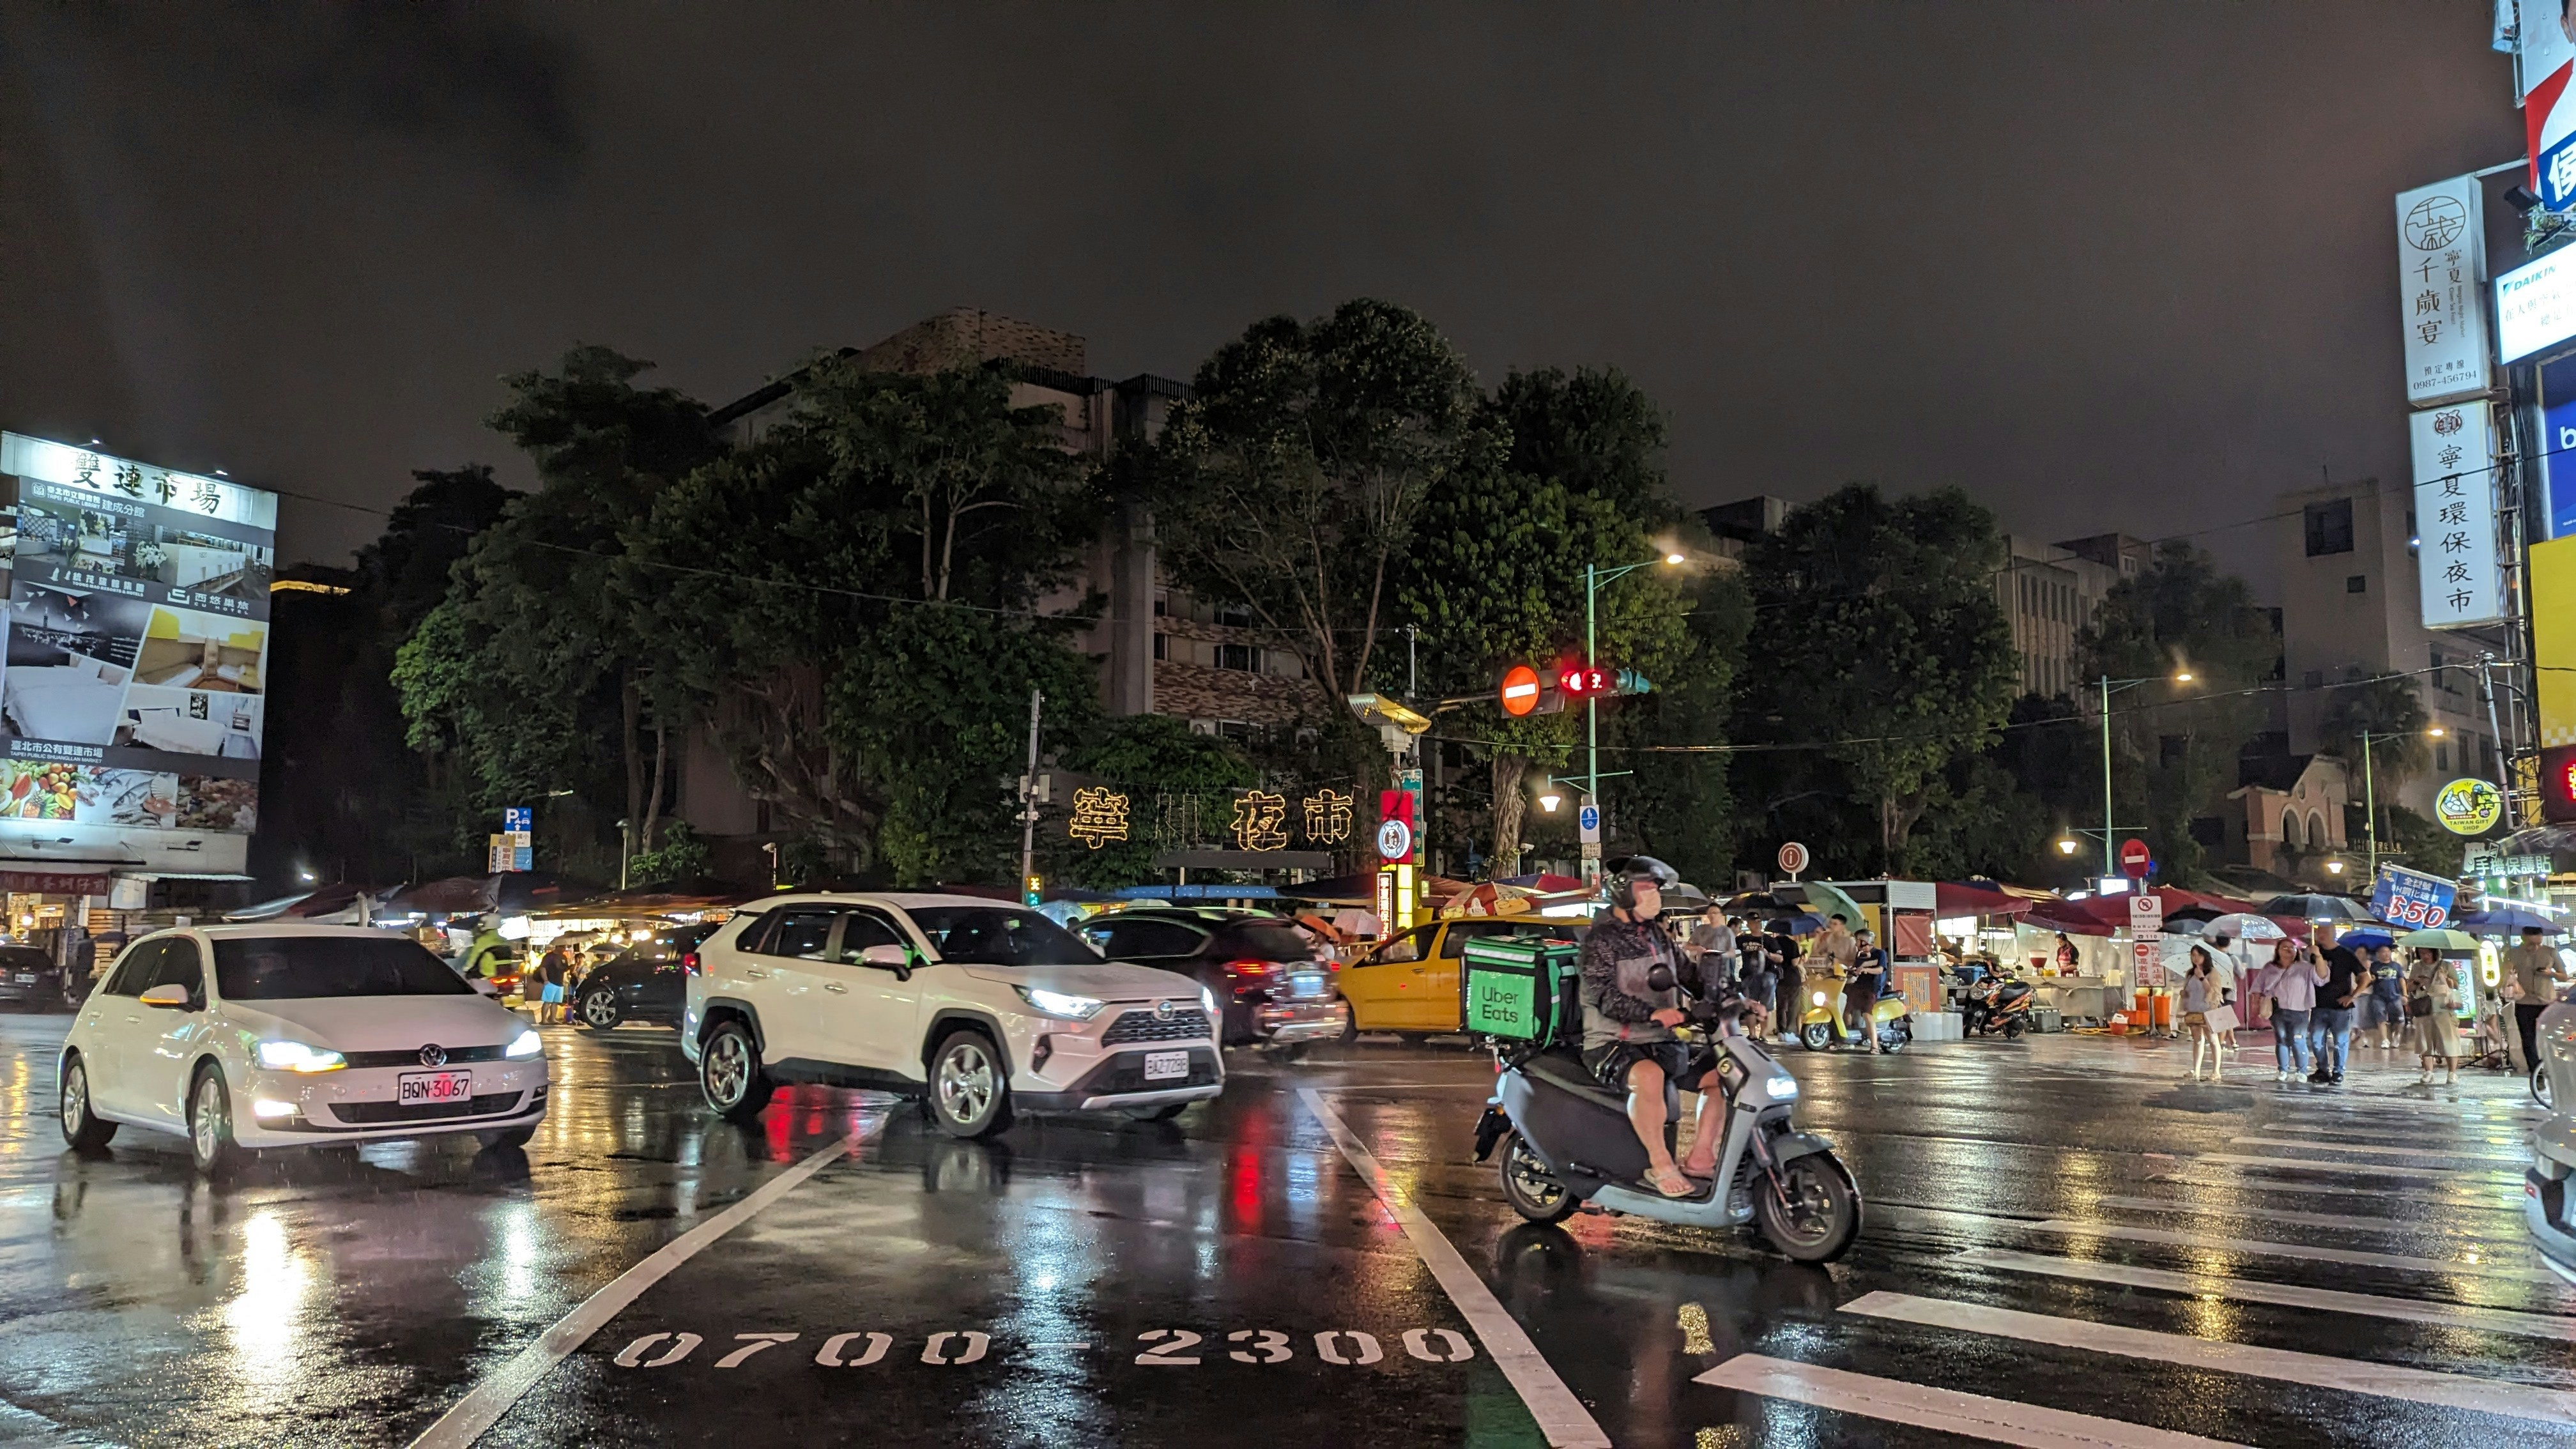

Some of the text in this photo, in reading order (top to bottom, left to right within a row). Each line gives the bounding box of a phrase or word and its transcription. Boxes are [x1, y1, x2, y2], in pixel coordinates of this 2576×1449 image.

[2444, 249, 2463, 285] 寧夏
[2514, 264, 2556, 291] DAIKIN
[2413, 257, 2443, 346] 千歲宴
[2413, 370, 2477, 390] 0987-456794
[72, 451, 221, 514] 雙連市場
[2437, 443, 2474, 614] 寧夏環保夜市
[506, 809, 519, 824] P
[2475, 855, 2552, 877] 手機保護貼
[2384, 894, 2446, 928] $50
[1482, 986, 1519, 1005] Uber
[1482, 1004, 1519, 1023] Eats
[613, 1332, 990, 1368] 0700
[1135, 1329, 1474, 1365] 2300
